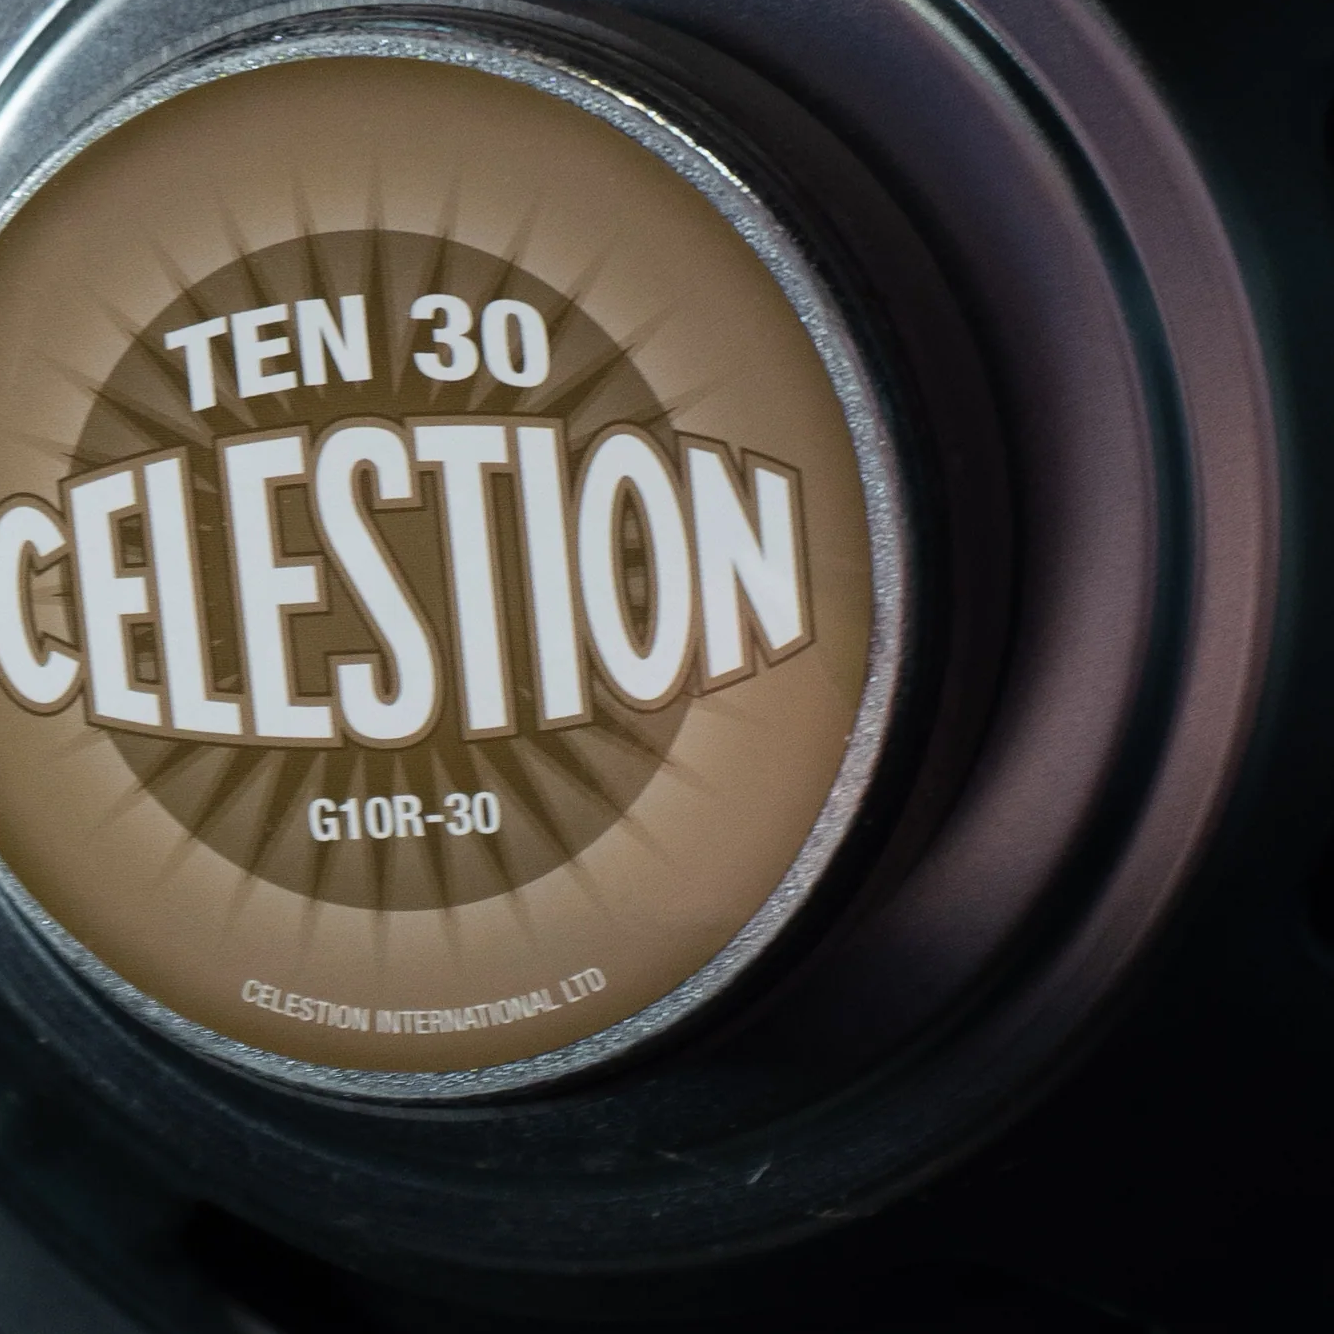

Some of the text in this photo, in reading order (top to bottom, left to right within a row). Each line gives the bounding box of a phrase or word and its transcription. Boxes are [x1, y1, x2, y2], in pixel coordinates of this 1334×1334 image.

[163, 292, 551, 413] TEN 30
[307, 790, 502, 843] G10R-30
[240, 966, 608, 1035] CELESTION INTERNATIONAL LTD
